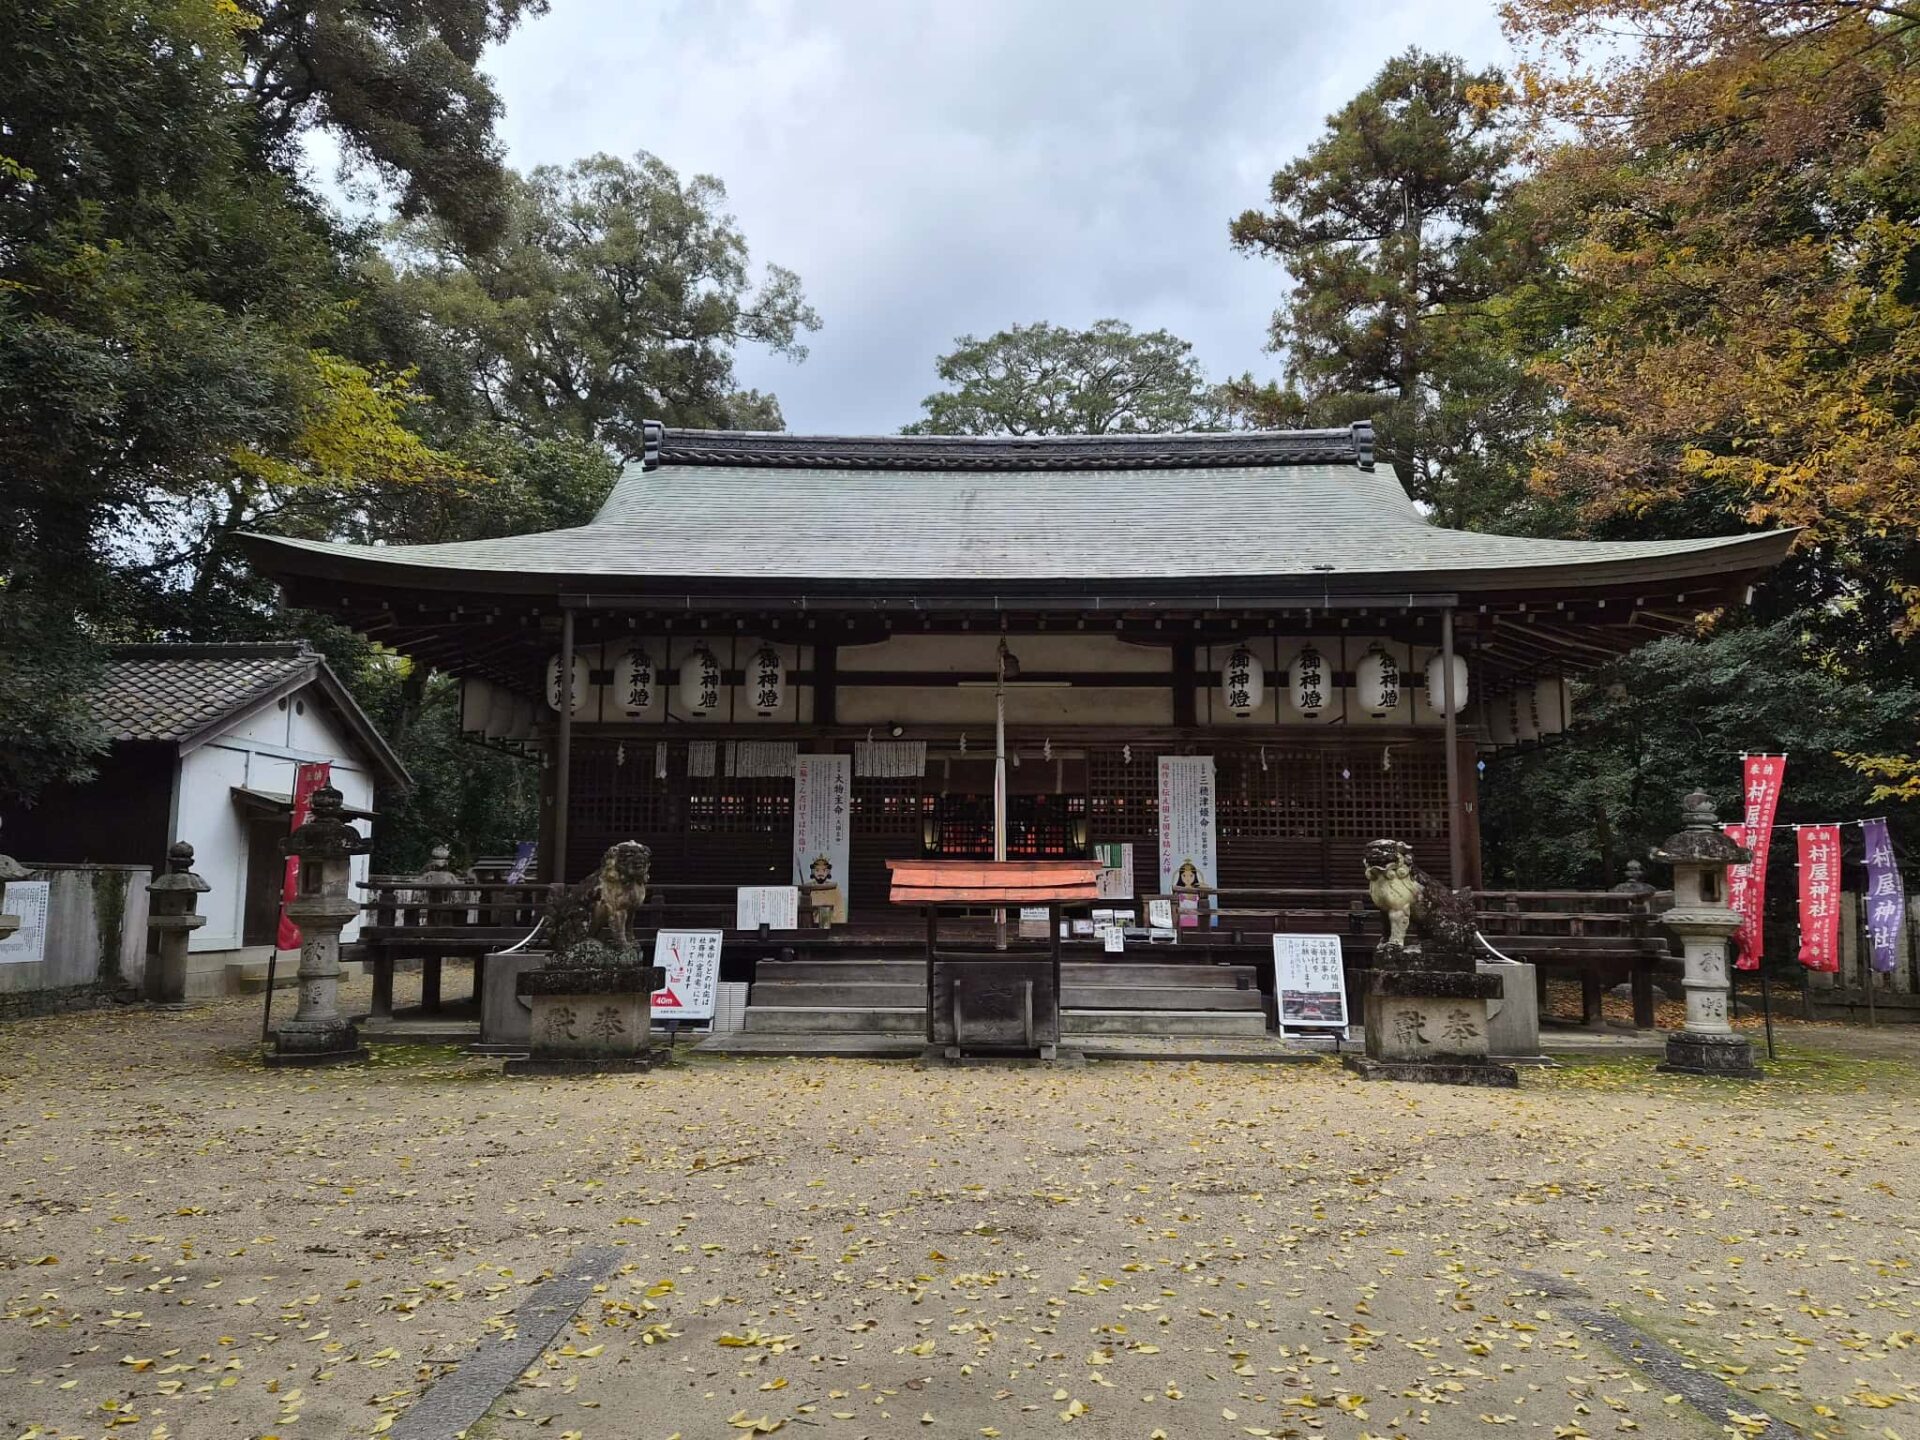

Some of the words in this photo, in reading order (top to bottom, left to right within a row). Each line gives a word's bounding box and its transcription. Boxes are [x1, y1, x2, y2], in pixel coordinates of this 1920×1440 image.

[629, 652, 651, 707] 御神燈
[699, 653, 719, 708] 御神燈
[758, 651, 778, 707] 御神燈
[1230, 653, 1250, 708] 御神燈
[1300, 653, 1322, 708] 御神燈
[1379, 653, 1399, 708] 御神燈
[833, 773, 845, 816] 大物主命
[1749, 763, 1774, 776] 奉納
[1199, 775, 1211, 829] 三穂津姫命
[1806, 831, 1831, 842] 奉納
[1807, 844, 1831, 918] 村屋神社
[1872, 846, 1898, 950] 村屋神社
[1301, 939, 1311, 989] お願いします
[656, 996, 674, 1005] 40m
